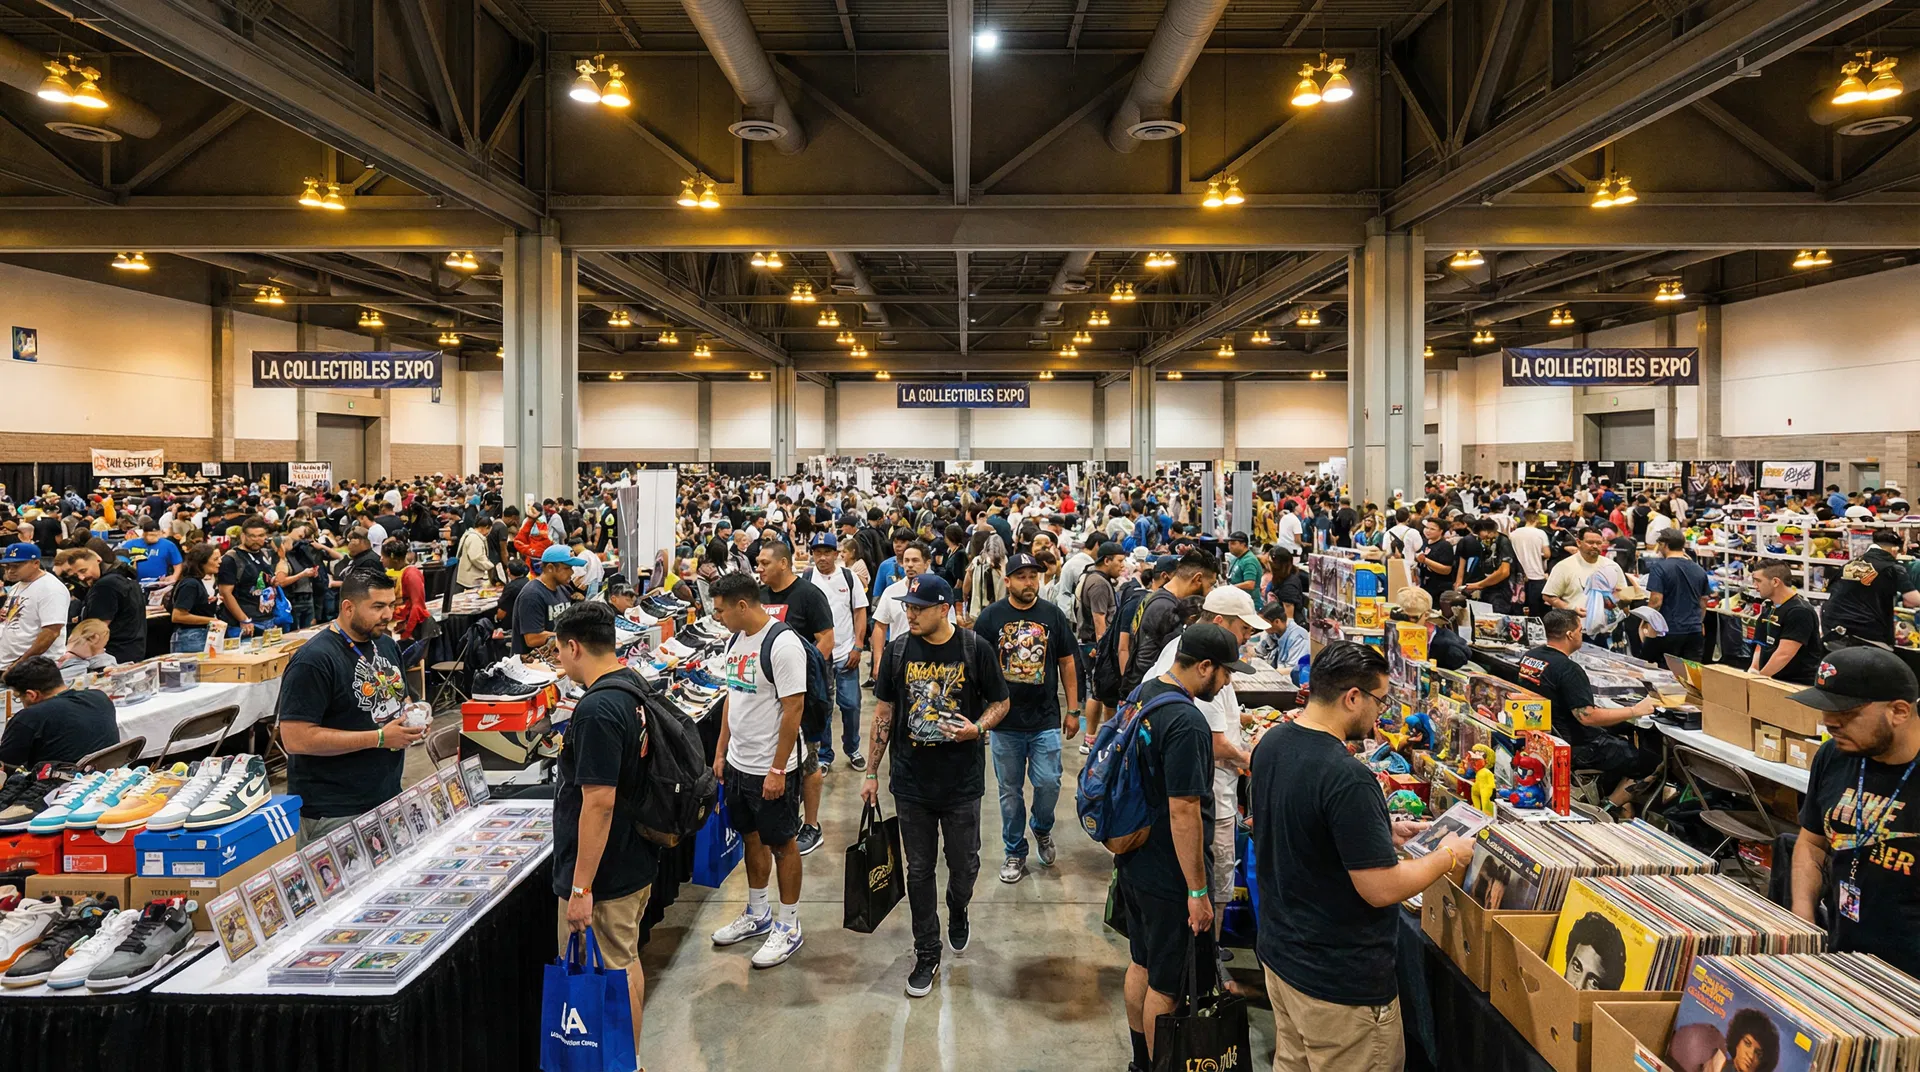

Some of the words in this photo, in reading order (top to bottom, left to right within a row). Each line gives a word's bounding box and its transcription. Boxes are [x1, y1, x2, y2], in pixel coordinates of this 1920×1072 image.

[260, 359, 280, 380] LA
[283, 359, 391, 380] COLLECTIBLES
[394, 359, 435, 380] EXPO
[1511, 357, 1532, 378] LA
[1534, 357, 1646, 378] COLLECTIBLES
[1650, 357, 1692, 378] EXPO
[902, 388, 916, 403] LA
[918, 388, 994, 403] COLLECTIBLES
[996, 388, 1025, 403] EXPO
